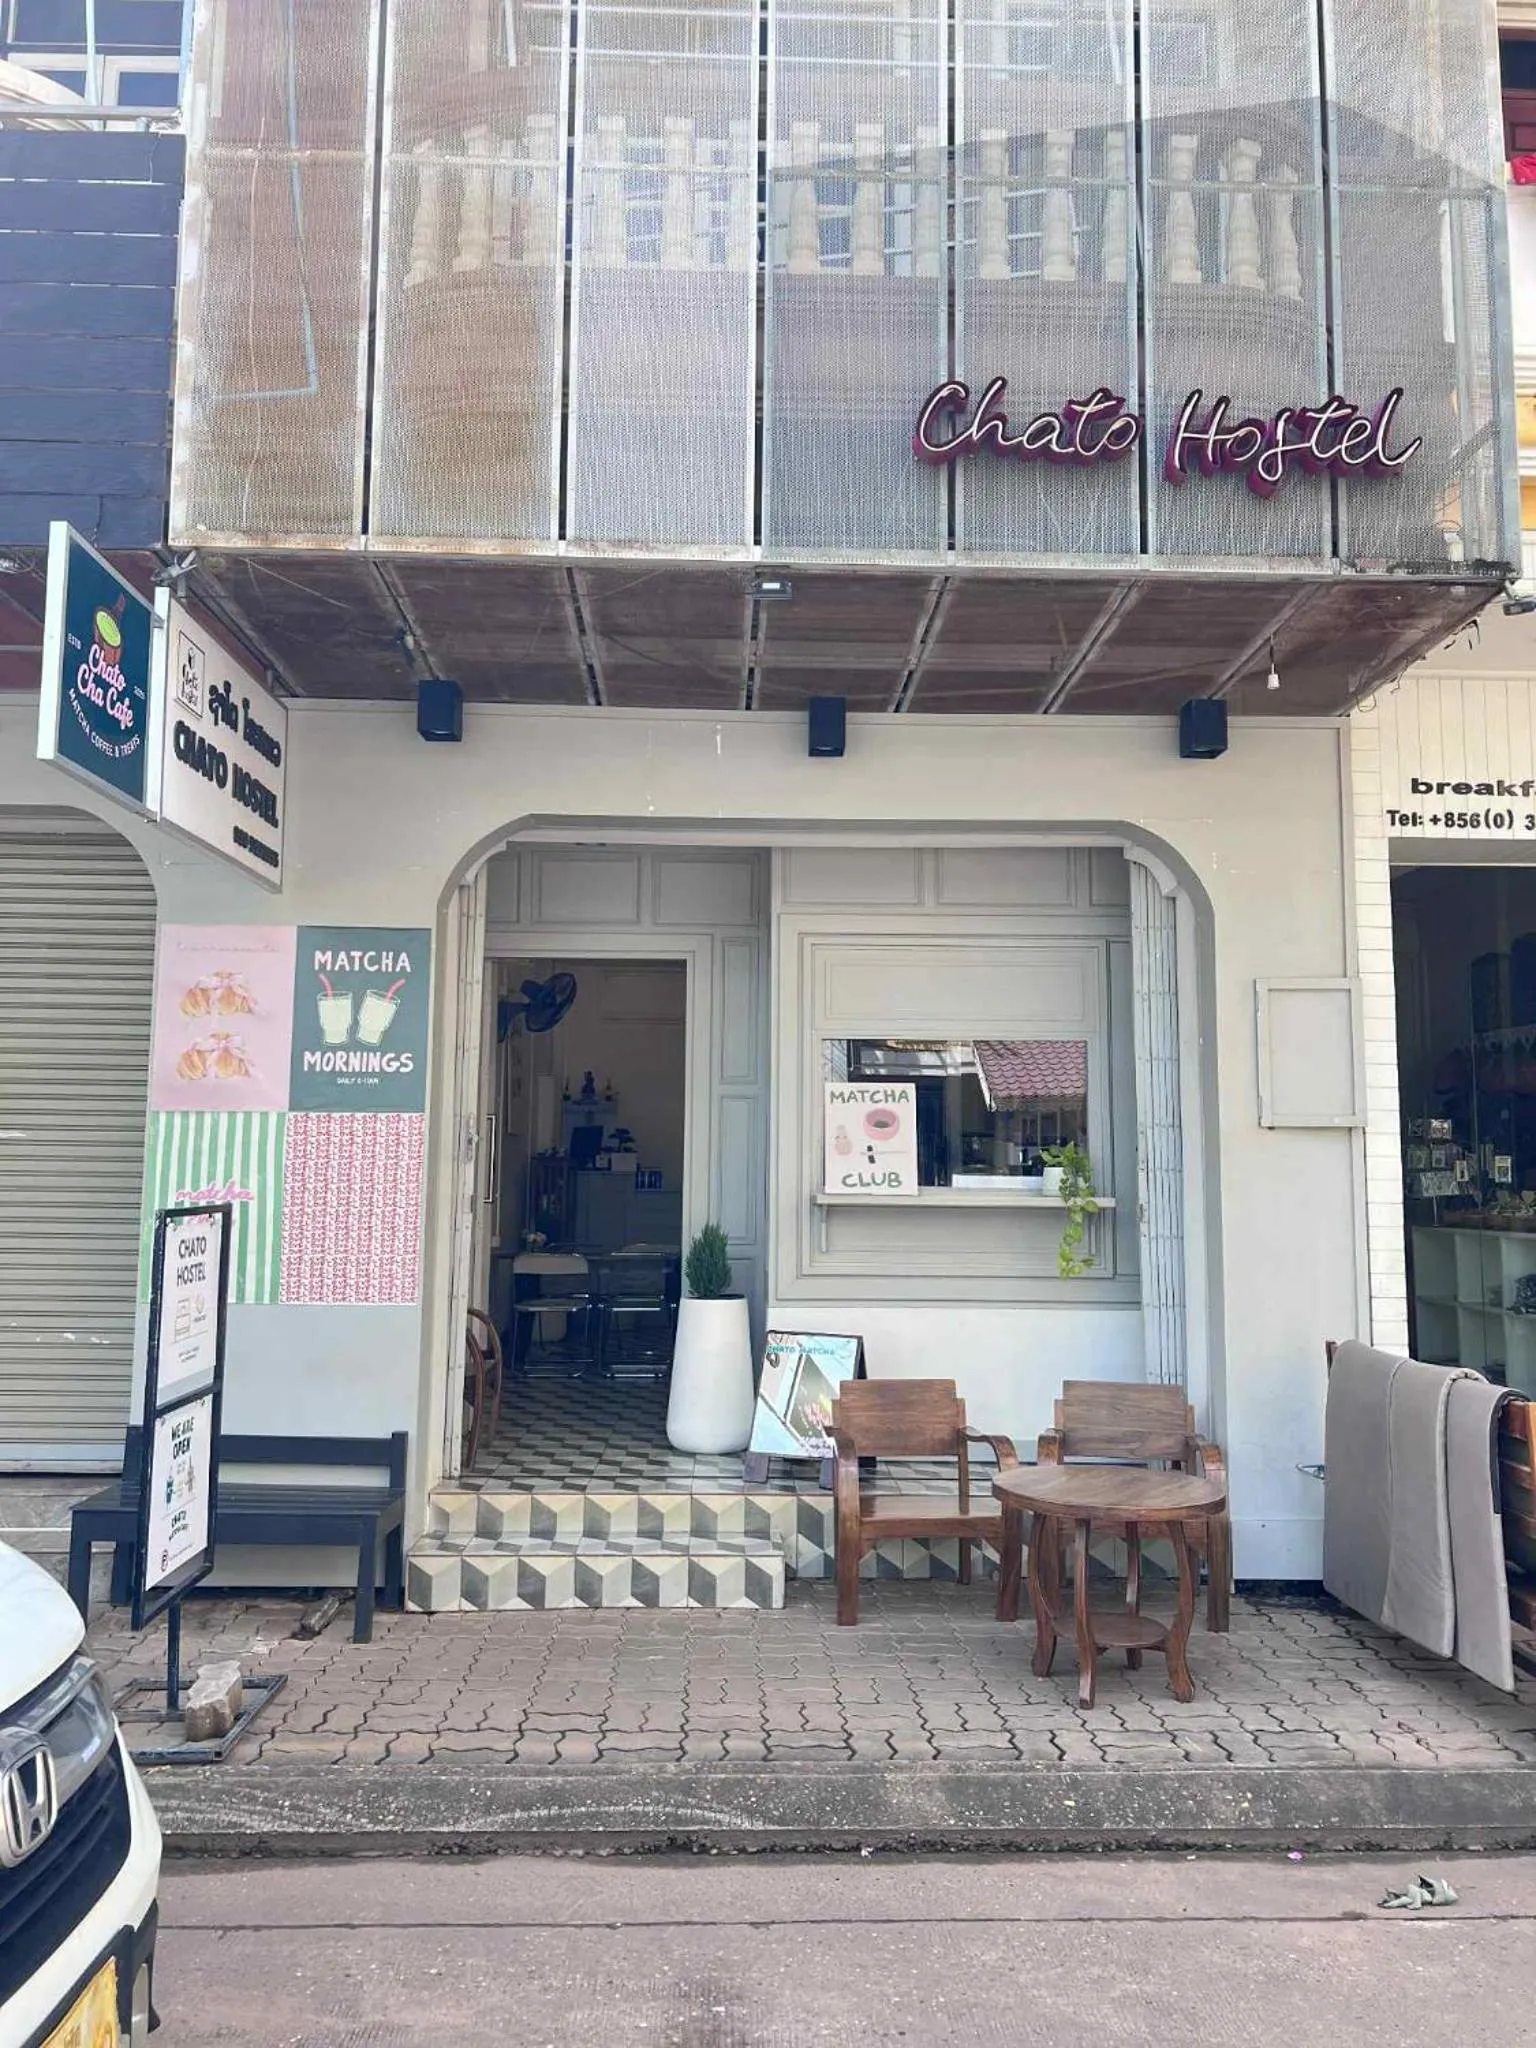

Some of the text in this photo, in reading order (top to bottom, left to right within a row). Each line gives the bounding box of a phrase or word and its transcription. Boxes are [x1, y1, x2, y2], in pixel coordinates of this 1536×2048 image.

[915, 377, 1423, 498] Chato Hostel
[88, 643, 126, 691] Chato
[77, 663, 134, 730] Cha Cafe
[69, 688, 91, 737] MATCHA
[90, 731, 113, 757] COFFEE
[120, 734, 141, 756] TREATS
[174, 720, 279, 829] CHATO HOSTEL
[1411, 777, 1536, 797] breakf
[1386, 810, 1423, 826] Tel:
[314, 951, 412, 973] MATCHA
[303, 1051, 414, 1073] MORNINGS
[830, 1088, 910, 1104] MATCHA
[175, 1179, 255, 1201] matcha
[841, 1171, 903, 1188] CLUB
[178, 1236, 207, 1259] CHATO
[176, 1263, 207, 1287] HOSTEL
[172, 1436, 191, 1460] OPEN
